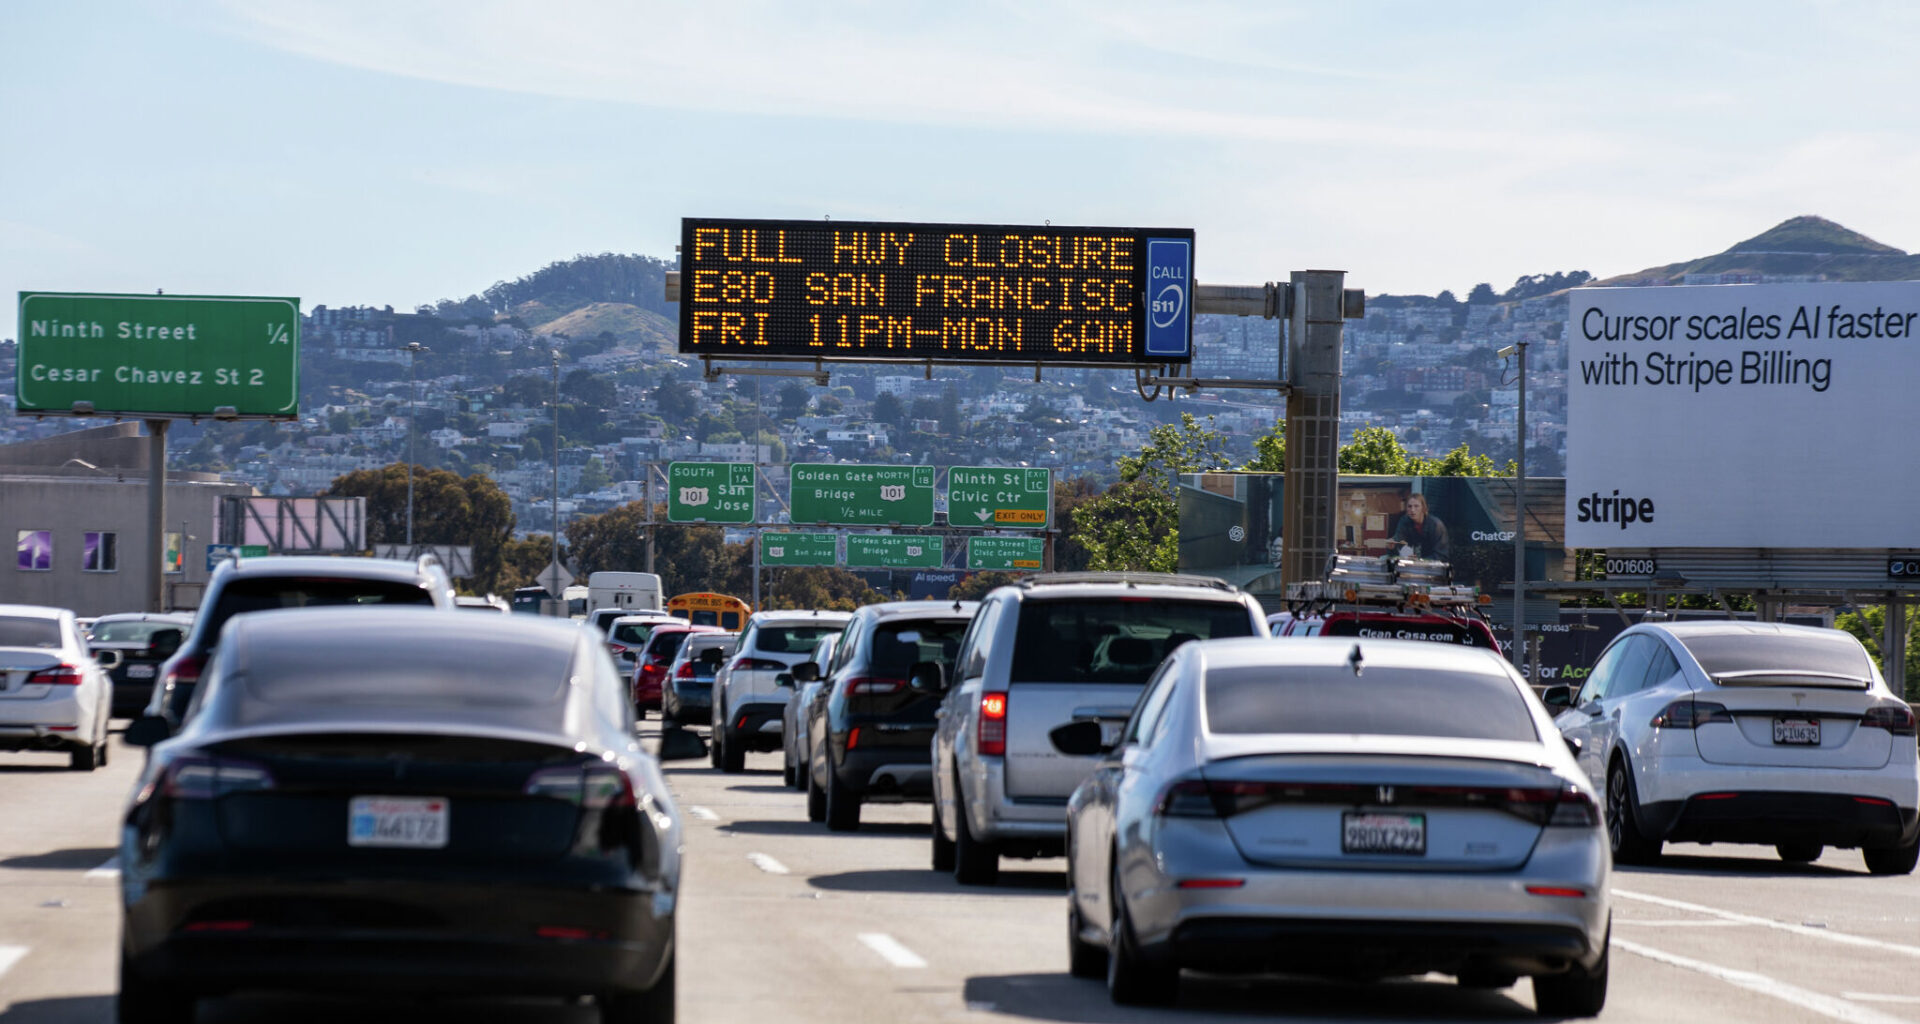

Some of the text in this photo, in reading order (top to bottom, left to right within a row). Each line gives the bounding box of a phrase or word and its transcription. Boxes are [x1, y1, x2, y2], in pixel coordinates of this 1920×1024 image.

[695, 228, 1135, 270] FULL HWY CLOSURE
[1152, 266, 1184, 279] CALL
[694, 270, 1134, 312] E80 SAN FRANCISC
[1152, 300, 1174, 313] 511
[1582, 304, 1919, 341] Cursor scales AI faster
[31, 320, 104, 338] Ninth
[117, 321, 196, 341] Street
[693, 311, 1133, 353] FRI 11PM-MON 6AM
[31, 364, 265, 386] Cesar Chavez St 2
[1581, 350, 1832, 393] with Stripe Billing
[674, 468, 715, 477] SOUTH
[797, 471, 910, 482] Golden Gate NORTH
[735, 475, 749, 483] 1A
[918, 476, 930, 485] 1B
[954, 472, 1021, 486] Ninth St
[718, 484, 746, 496] San
[1031, 481, 1044, 490] 1C
[685, 491, 702, 502] 101
[815, 489, 856, 502] Bridge
[885, 488, 902, 499] 101
[951, 490, 1022, 503] Civic Ctr
[713, 499, 750, 511] Jose
[1577, 489, 1655, 531] stripe
[859, 508, 884, 517] MILE
[996, 512, 1045, 521] EXIT ONLY
[852, 537, 878, 545] Golden
[882, 537, 901, 545] Gate
[1471, 530, 1517, 541] ChatGP
[974, 539, 1026, 548] Ninth Street
[863, 547, 888, 556] Bridge
[974, 549, 995, 557] Civic
[1606, 559, 1655, 575] 001608
[1359, 628, 1454, 641] Clean Casa.com
